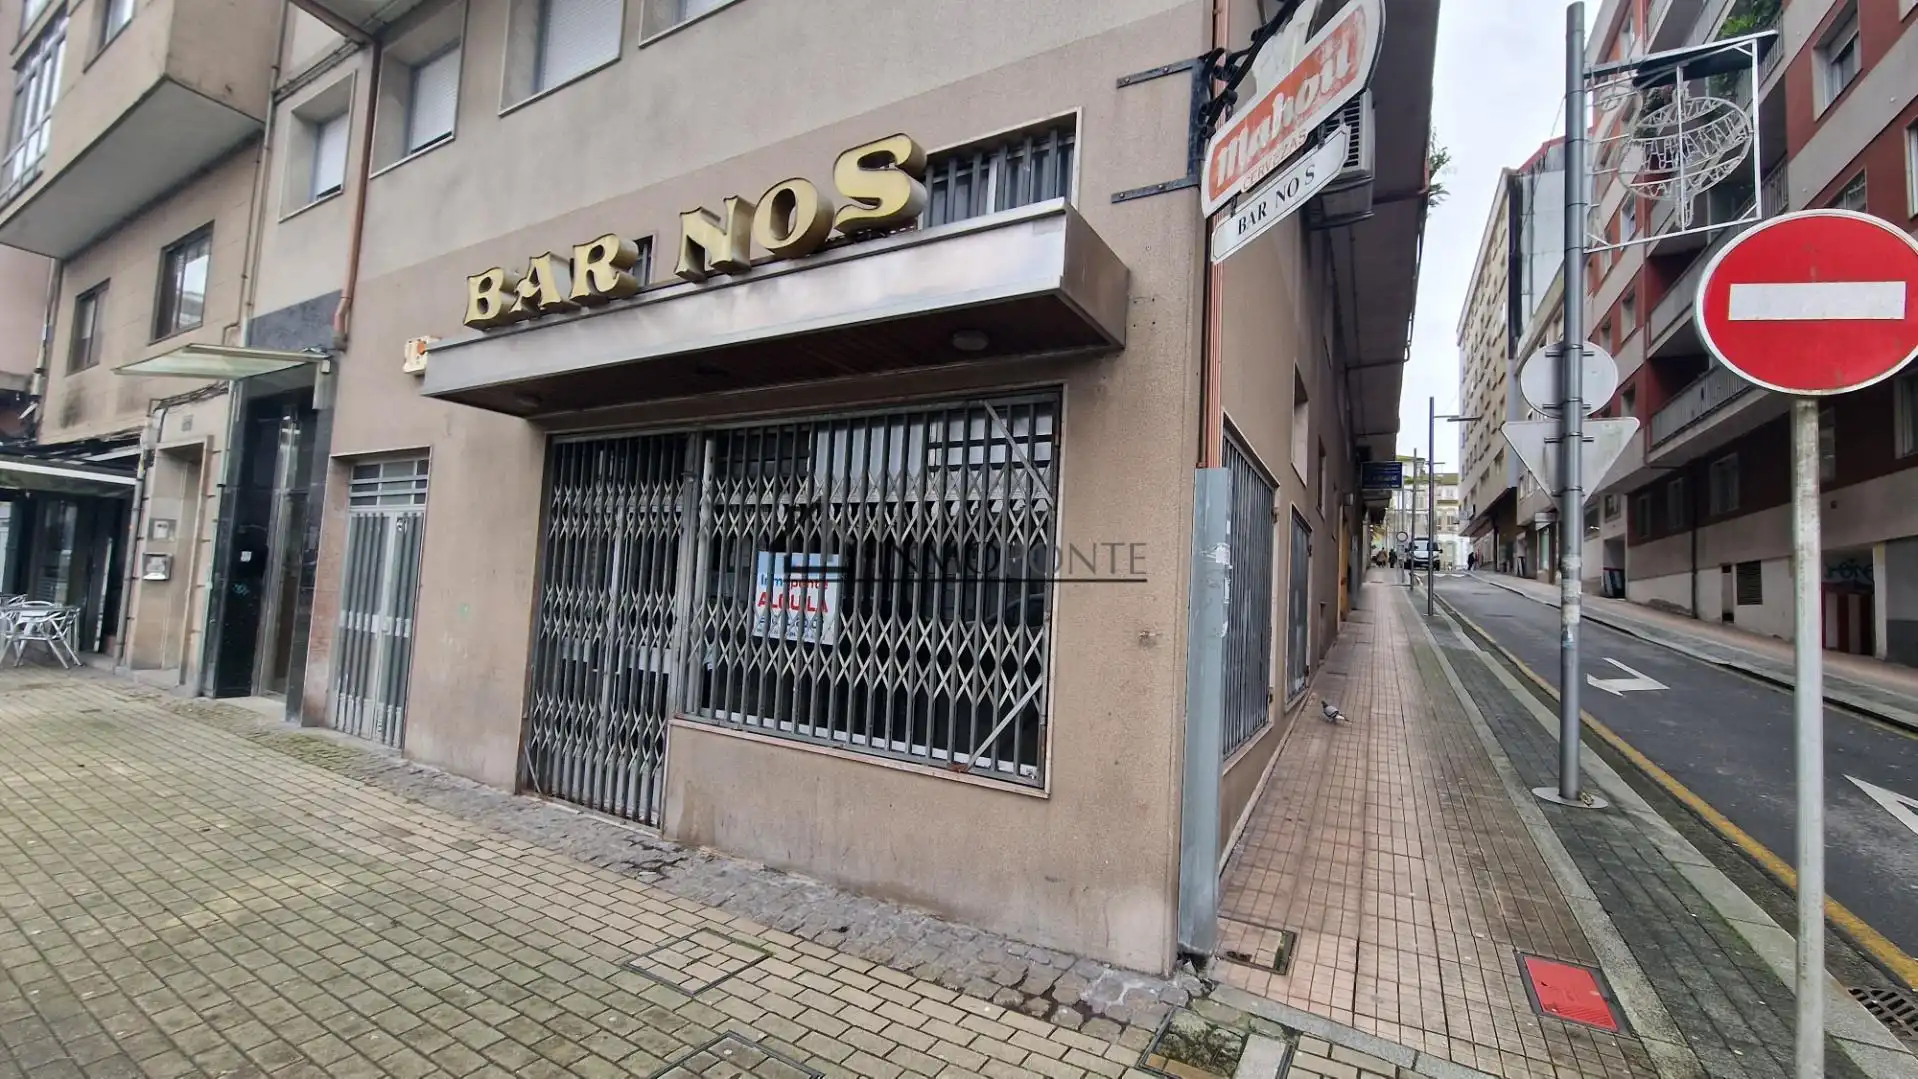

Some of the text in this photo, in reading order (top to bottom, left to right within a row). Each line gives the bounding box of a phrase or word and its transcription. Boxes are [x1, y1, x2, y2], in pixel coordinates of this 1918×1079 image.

[463, 132, 928, 331] BAR NOS
[1237, 200, 1268, 236] BAR
[757, 591, 829, 613] ALULA
